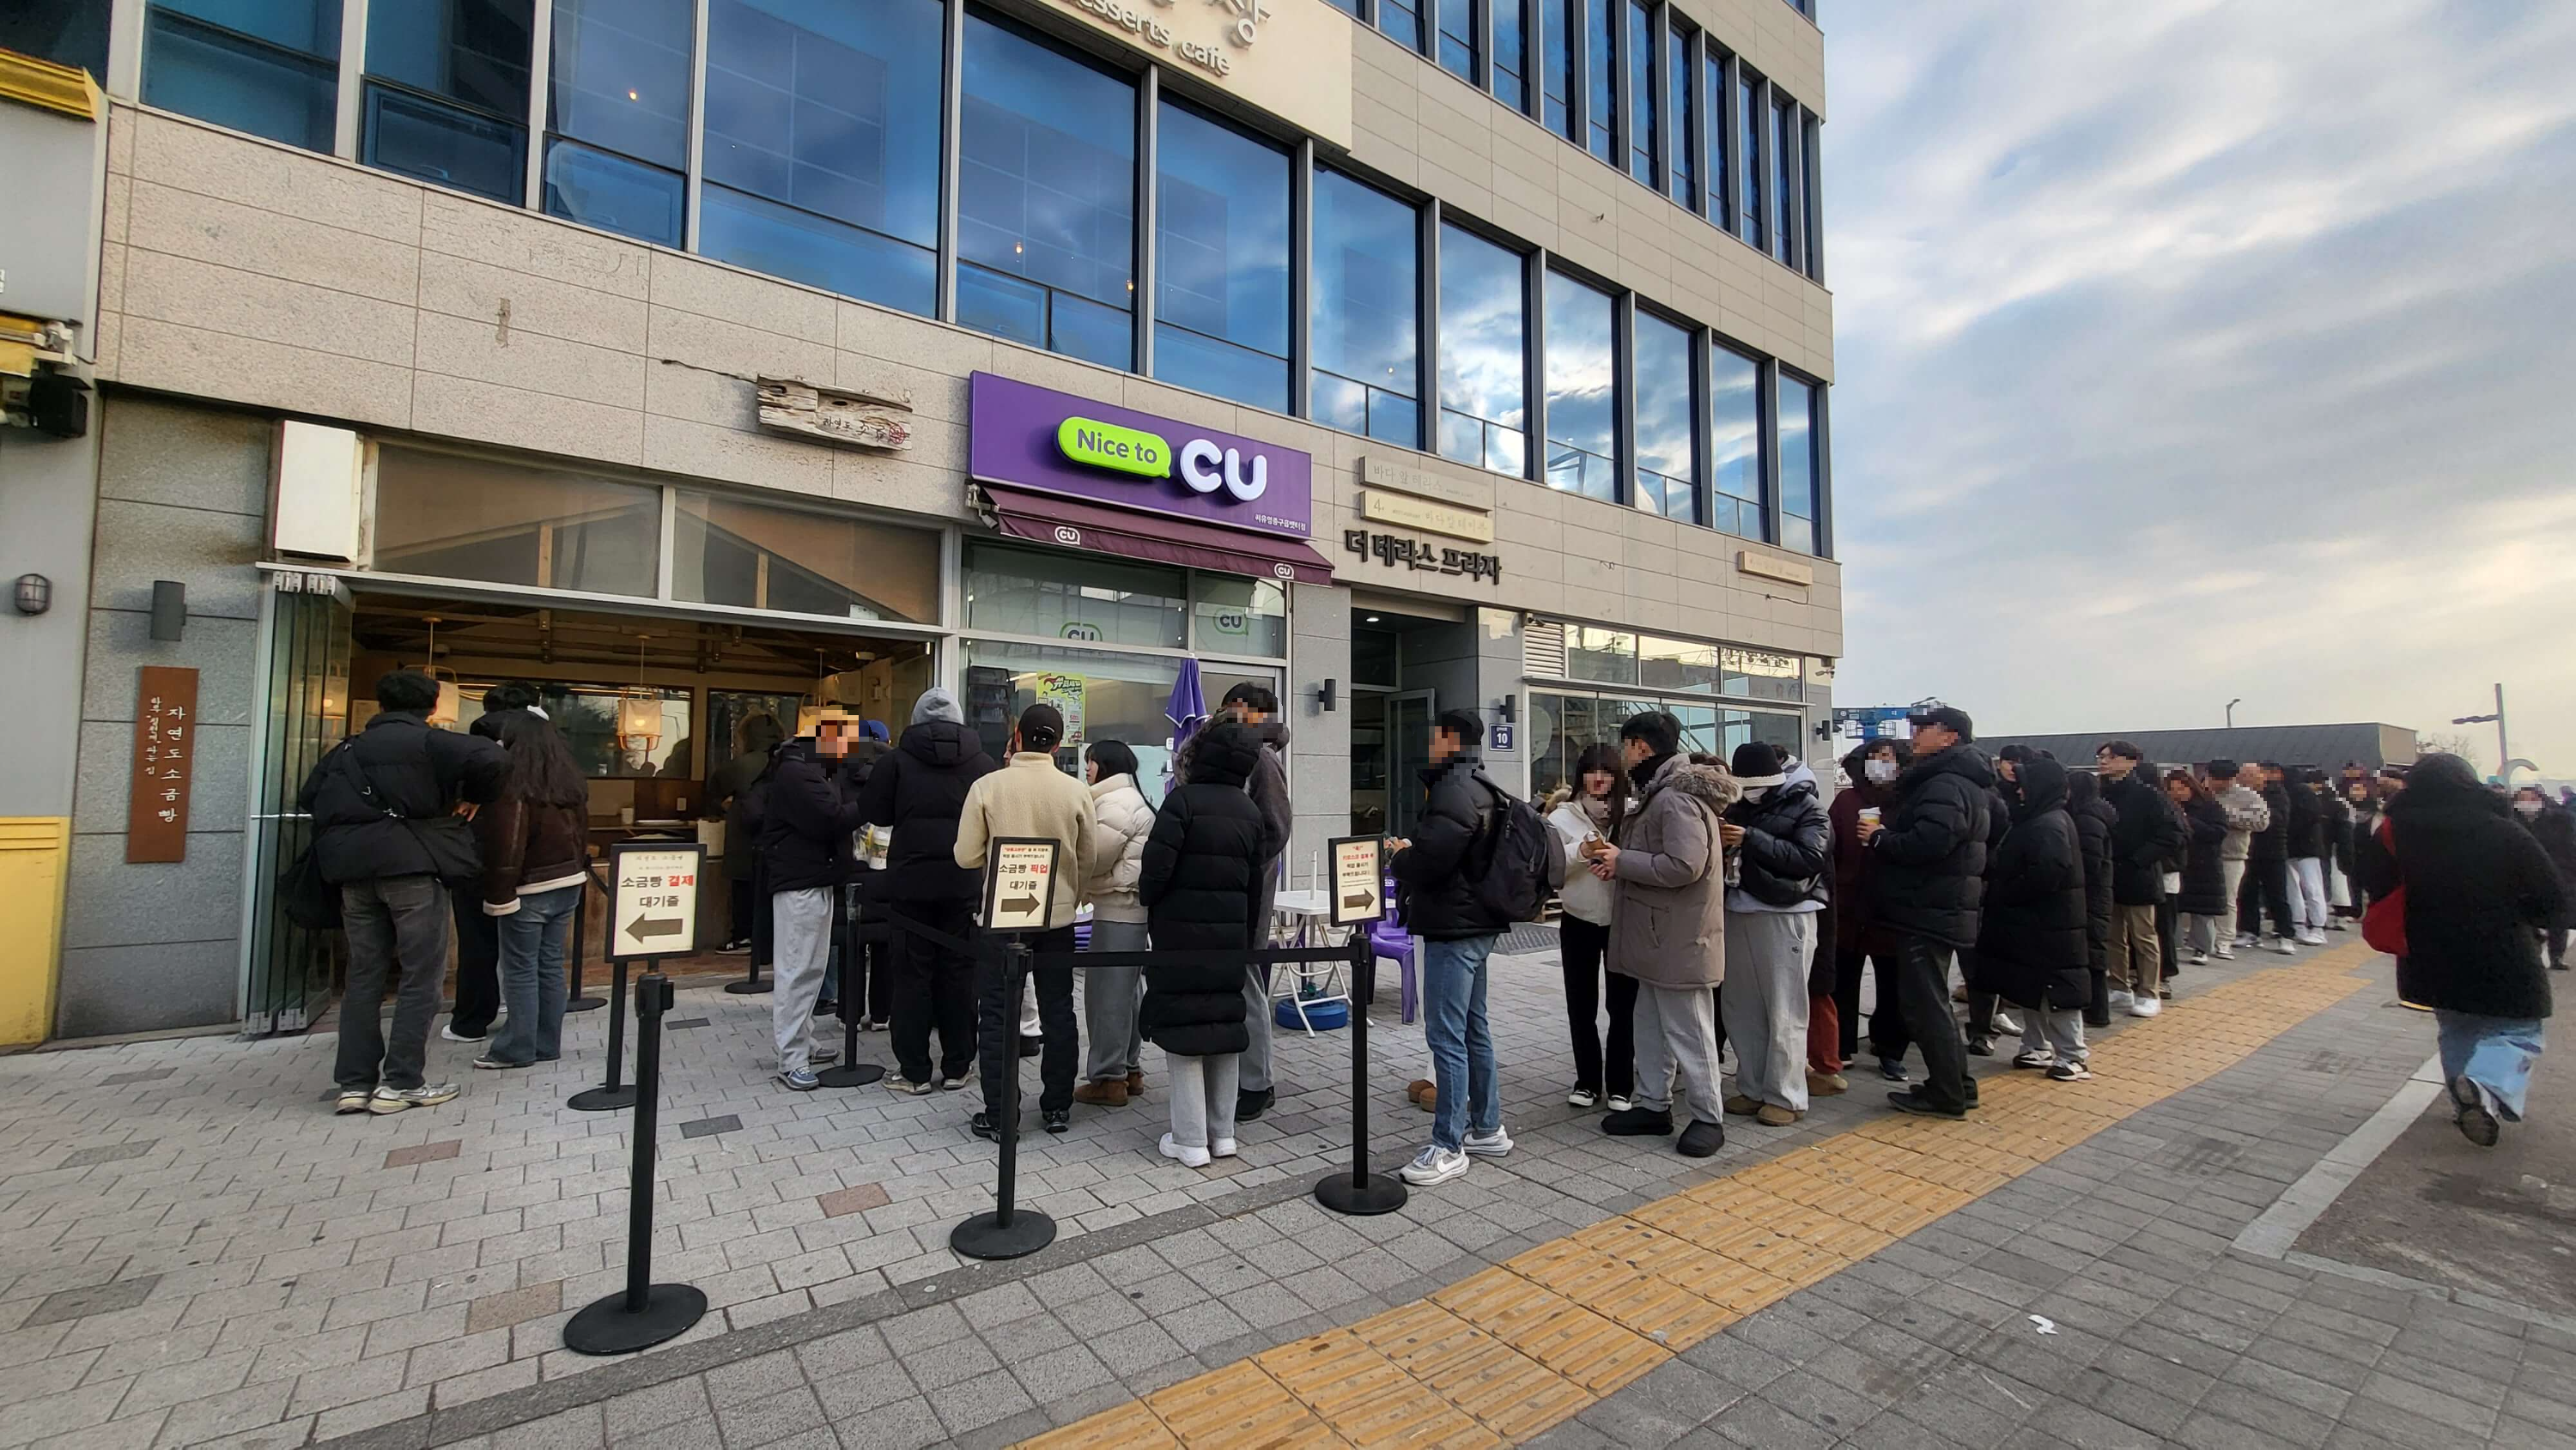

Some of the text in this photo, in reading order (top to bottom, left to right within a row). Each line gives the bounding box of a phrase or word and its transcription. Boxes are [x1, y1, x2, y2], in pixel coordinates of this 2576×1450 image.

[1180, 40, 1231, 76] cafe
[1077, 428, 1157, 464] Nice to
[1179, 438, 1268, 502] CU
[1374, 464, 1395, 482] 바다
[1412, 474, 1443, 492] 테라스
[1345, 530, 1503, 585] 더 테라스 프라자
[1497, 732, 1508, 744] 10
[999, 865, 1048, 874] 소금빵 픽업
[621, 875, 695, 888] 소금빵 결제
[1010, 881, 1037, 890] 대기줄
[639, 895, 679, 907] 대기줄
